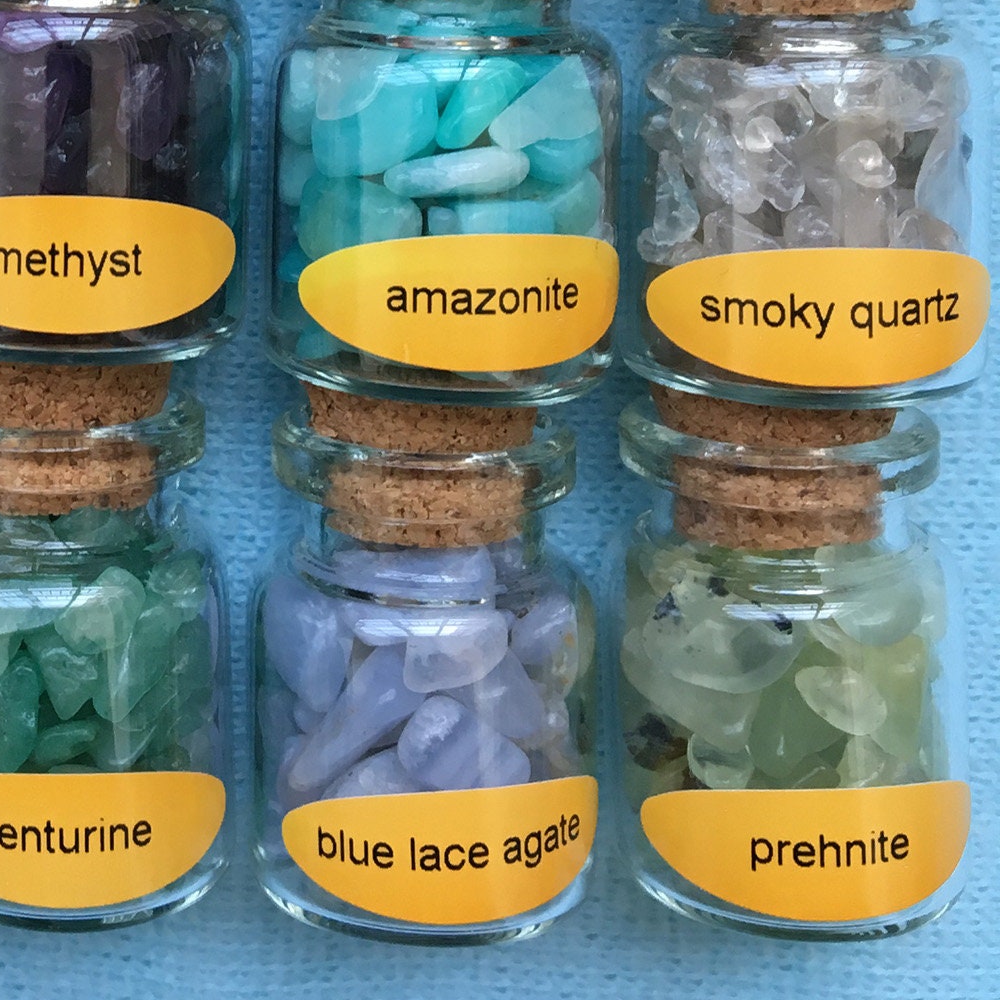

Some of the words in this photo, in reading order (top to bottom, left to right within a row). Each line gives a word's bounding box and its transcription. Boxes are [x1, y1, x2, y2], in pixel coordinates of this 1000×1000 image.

[386, 278, 579, 315] amazonite
[700, 293, 835, 340] smoky
[850, 288, 959, 339] quartz
[317, 826, 394, 869] blue
[410, 836, 490, 872] lace
[503, 814, 580, 869] agate
[750, 830, 909, 872] prehnite
